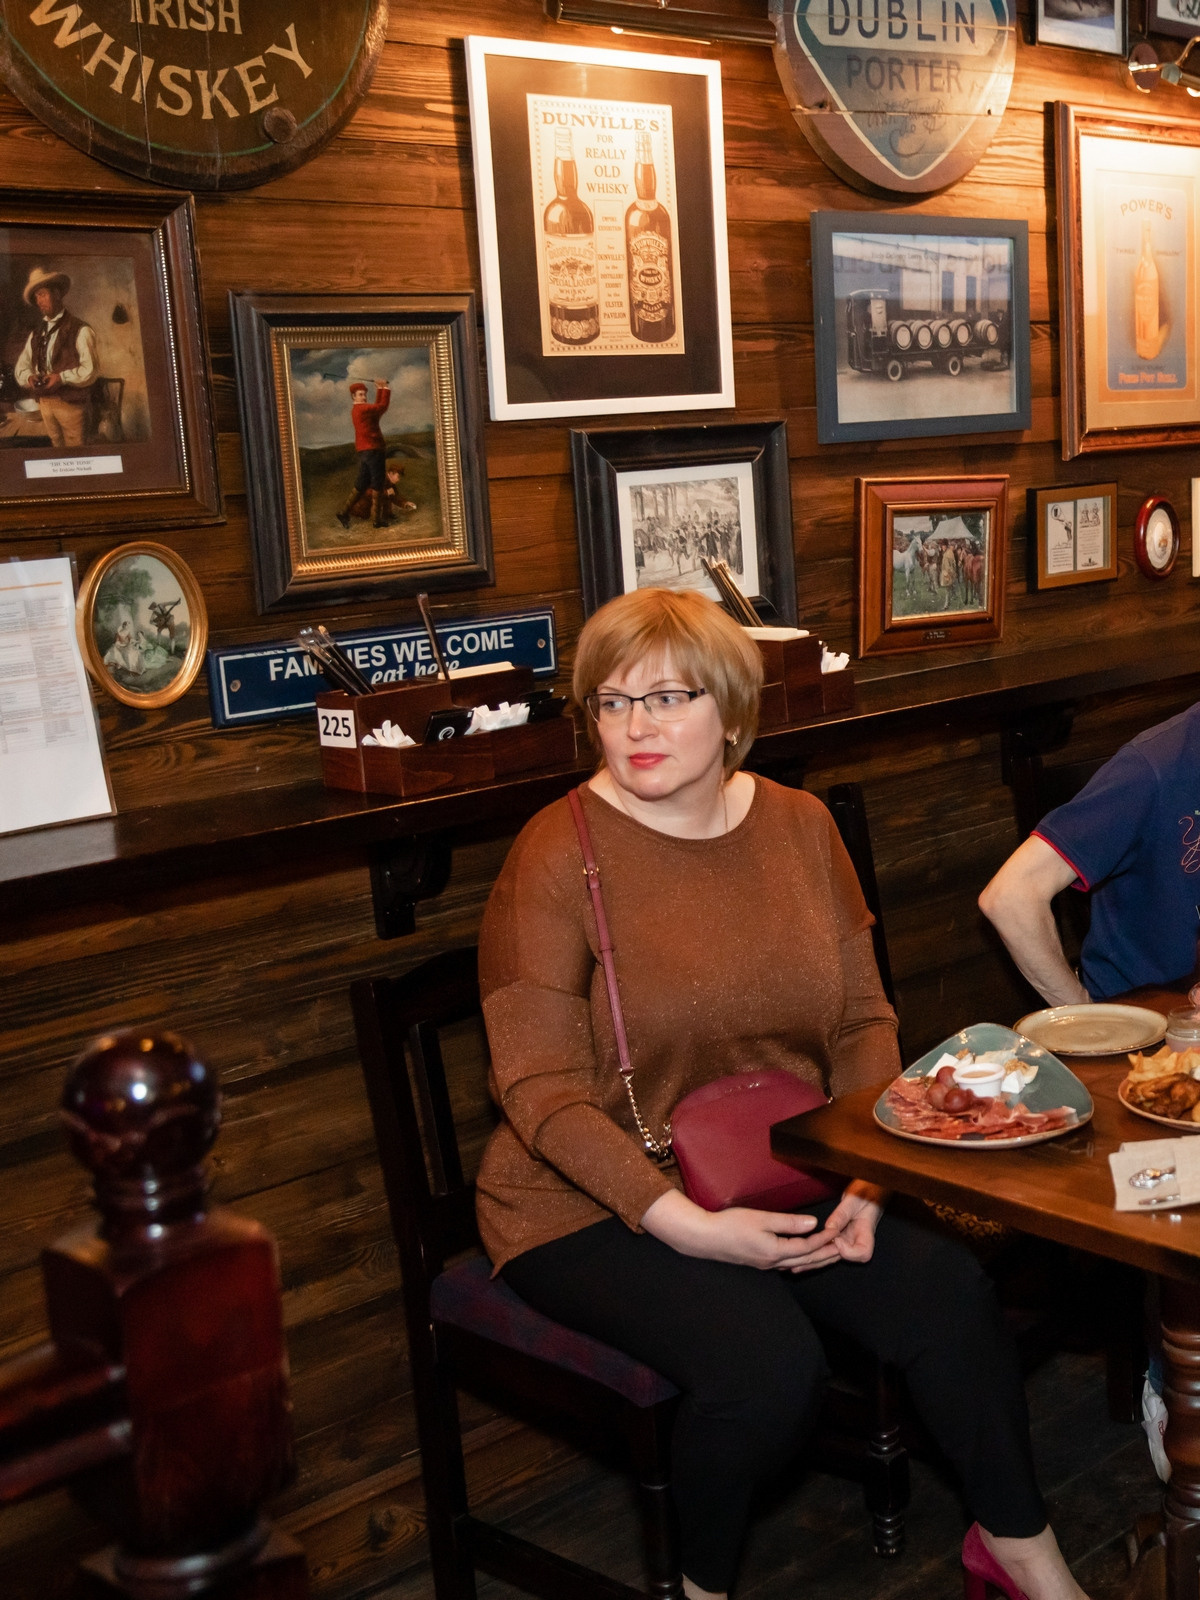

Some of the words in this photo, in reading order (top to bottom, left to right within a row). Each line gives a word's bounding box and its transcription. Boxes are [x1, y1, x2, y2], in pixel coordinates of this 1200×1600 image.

[827, 0, 977, 45] DUBLIN
[29, 0, 314, 120] WHISKEY
[847, 54, 963, 94] PORTER
[542, 111, 660, 132] DUNVILLE'S
[596, 134, 614, 143] FOR
[585, 147, 627, 161] REALLY
[594, 165, 621, 179] OLD
[586, 182, 630, 195] WHISKY
[1120, 198, 1173, 221] POWER'S
[392, 628, 514, 664] WECOME
[321, 714, 352, 739] 225
